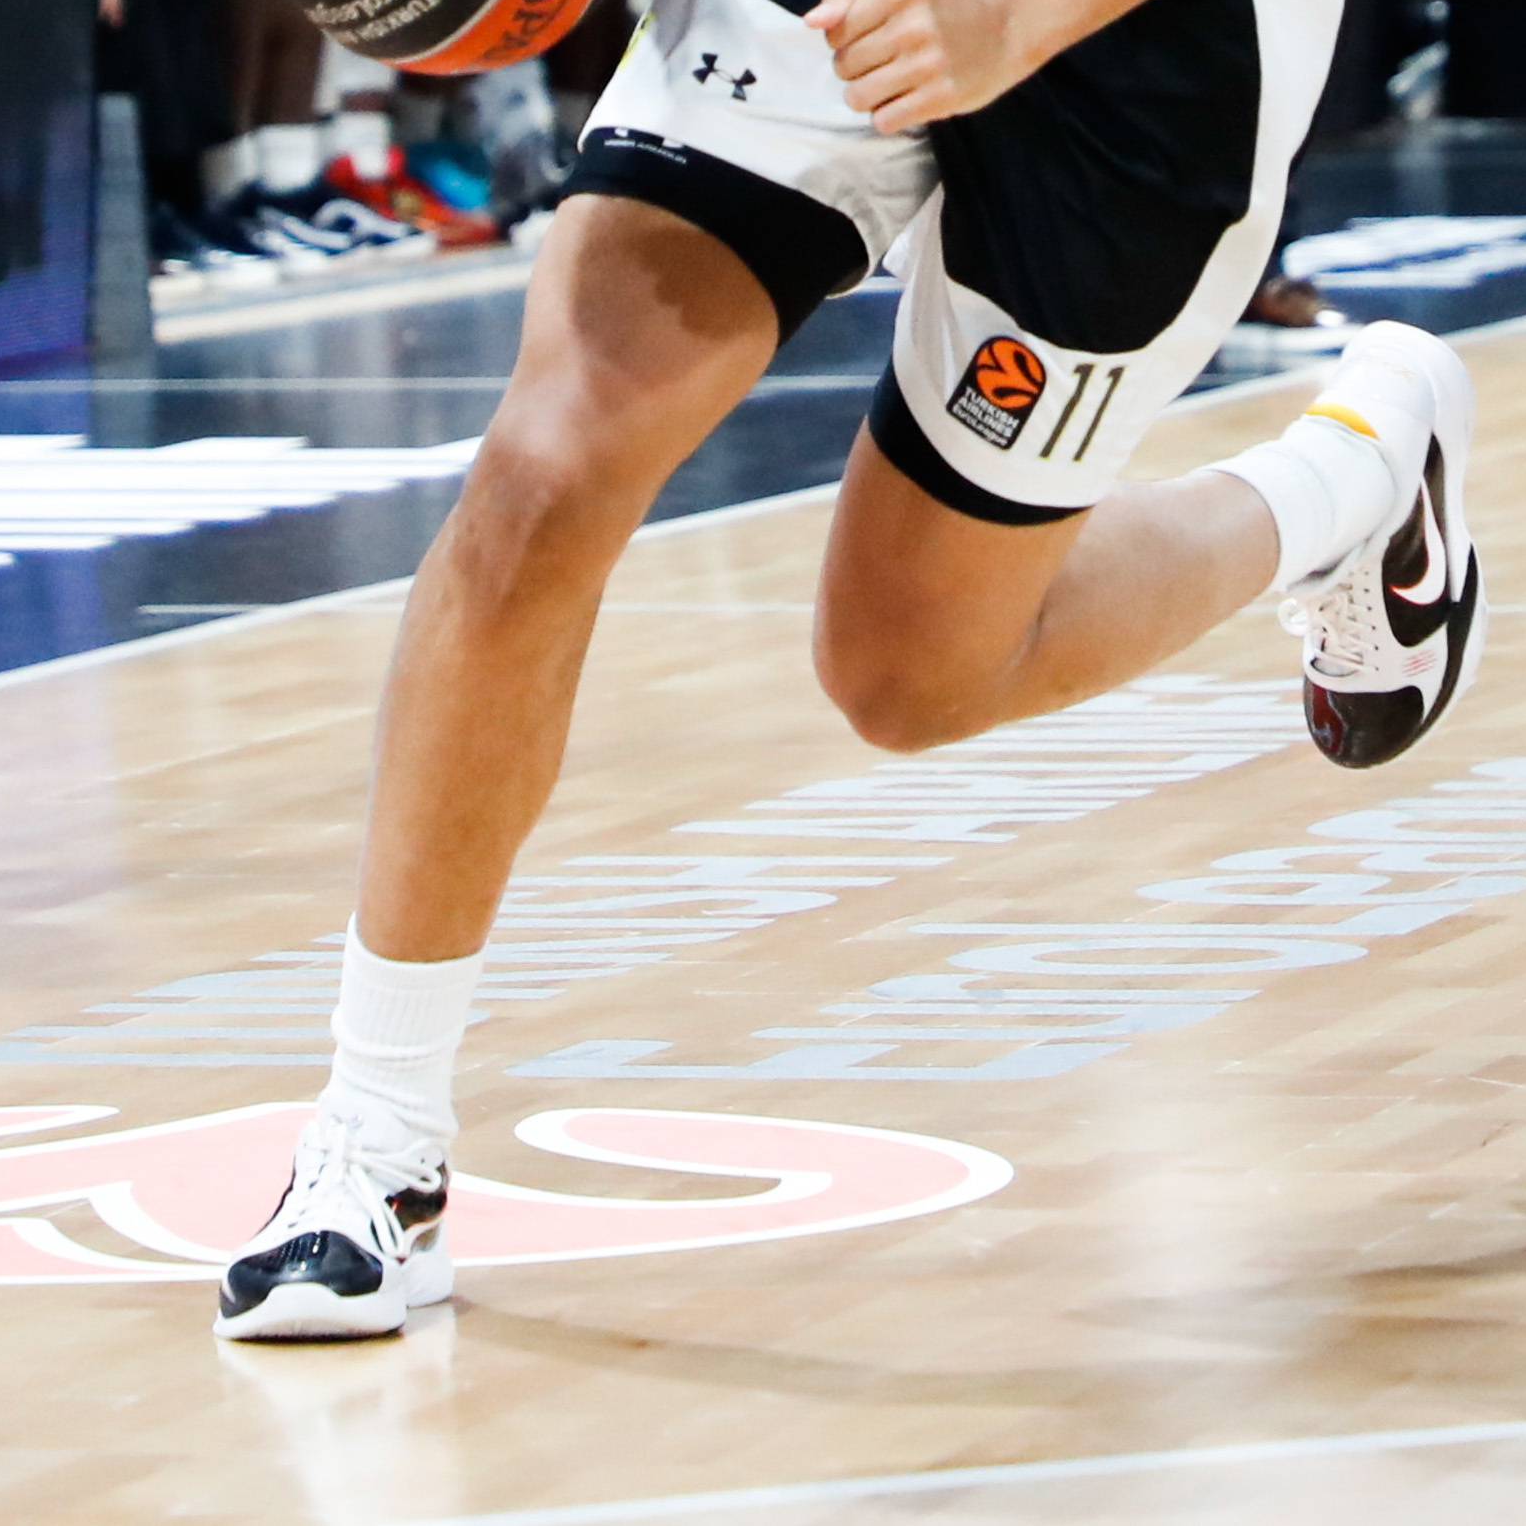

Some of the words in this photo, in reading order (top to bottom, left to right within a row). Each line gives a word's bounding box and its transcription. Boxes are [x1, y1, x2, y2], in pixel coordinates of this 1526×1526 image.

[956, 396, 1013, 437] AIRLINES
[964, 385, 1019, 428] TURKISH
[1039, 363, 1125, 461] 11
